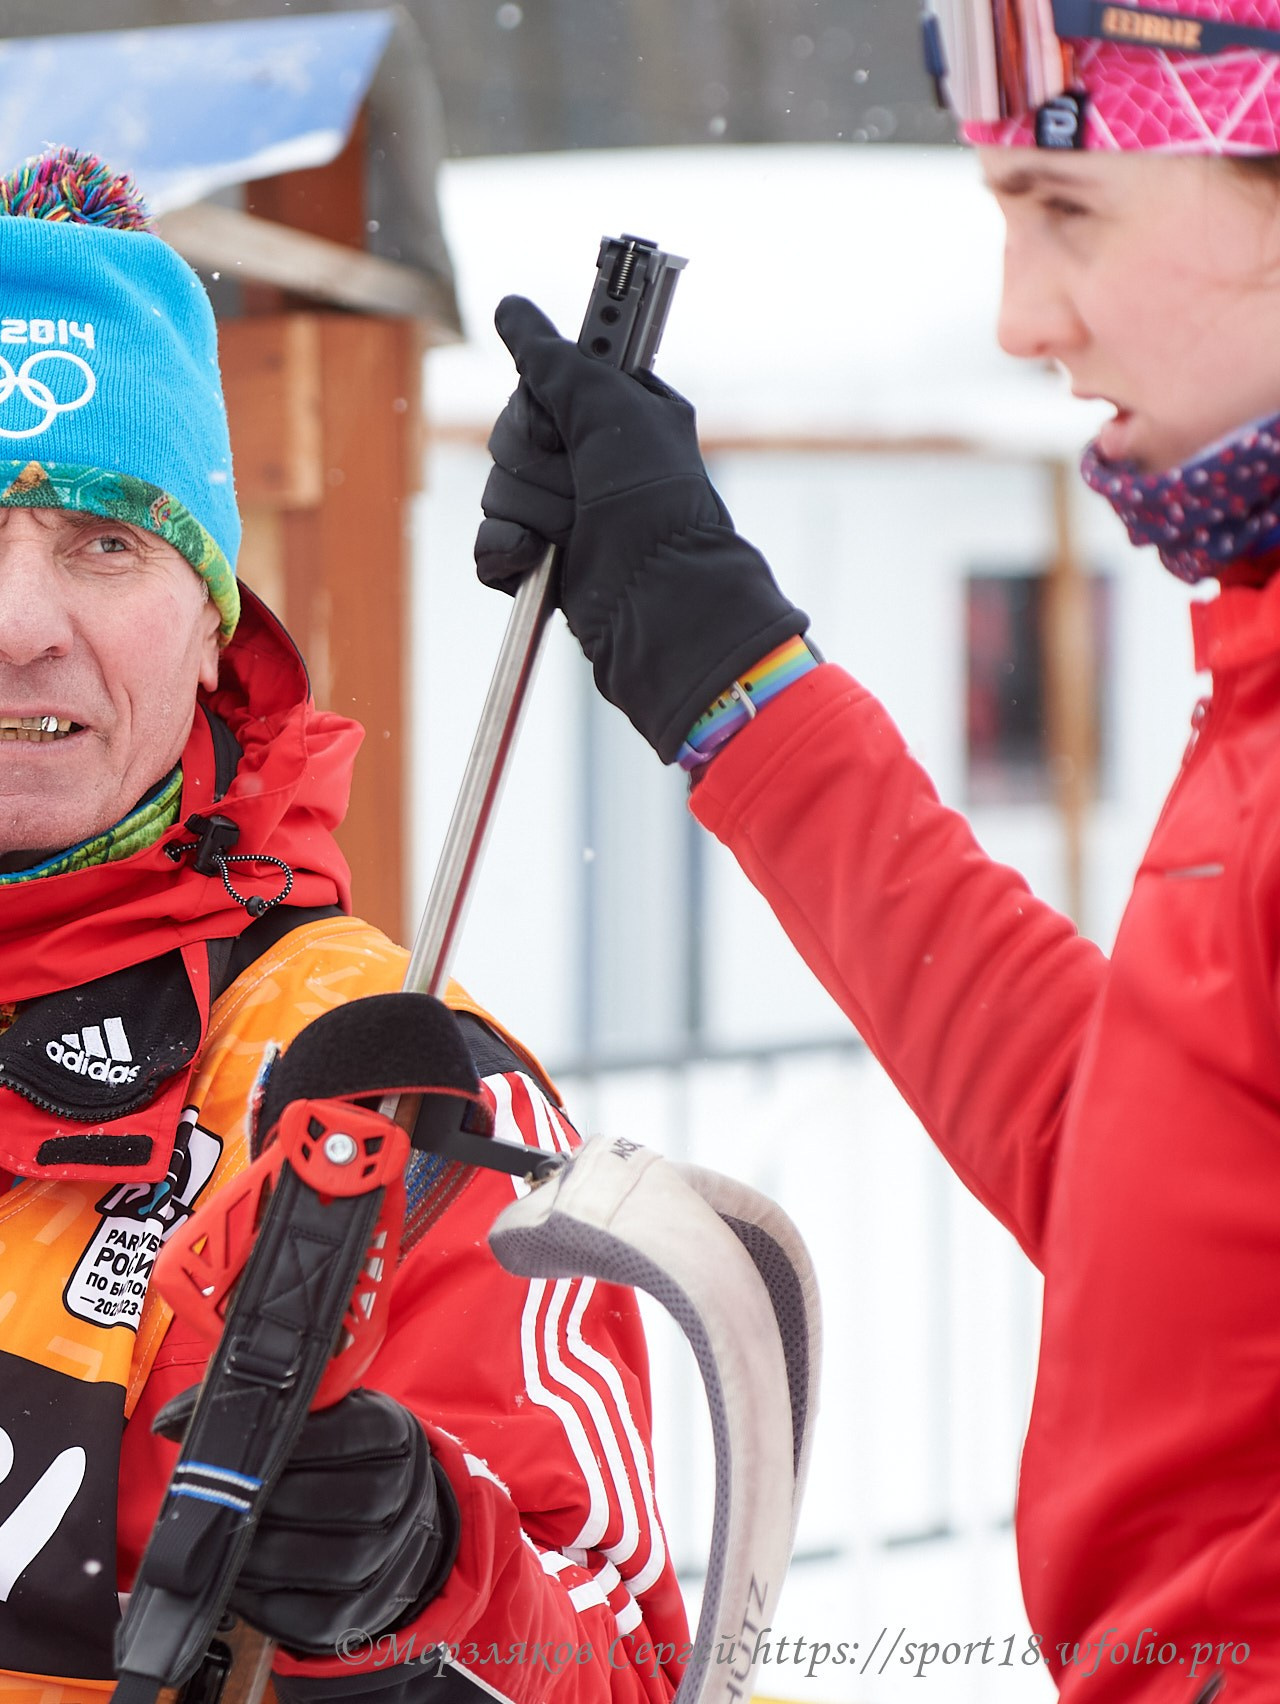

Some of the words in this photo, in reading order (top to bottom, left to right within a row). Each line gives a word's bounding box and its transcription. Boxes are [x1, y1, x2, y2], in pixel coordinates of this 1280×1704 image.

[0, 318, 95, 350] 2014
[45, 1040, 141, 1084] adidas
[85, 1271, 109, 1291] ПО
